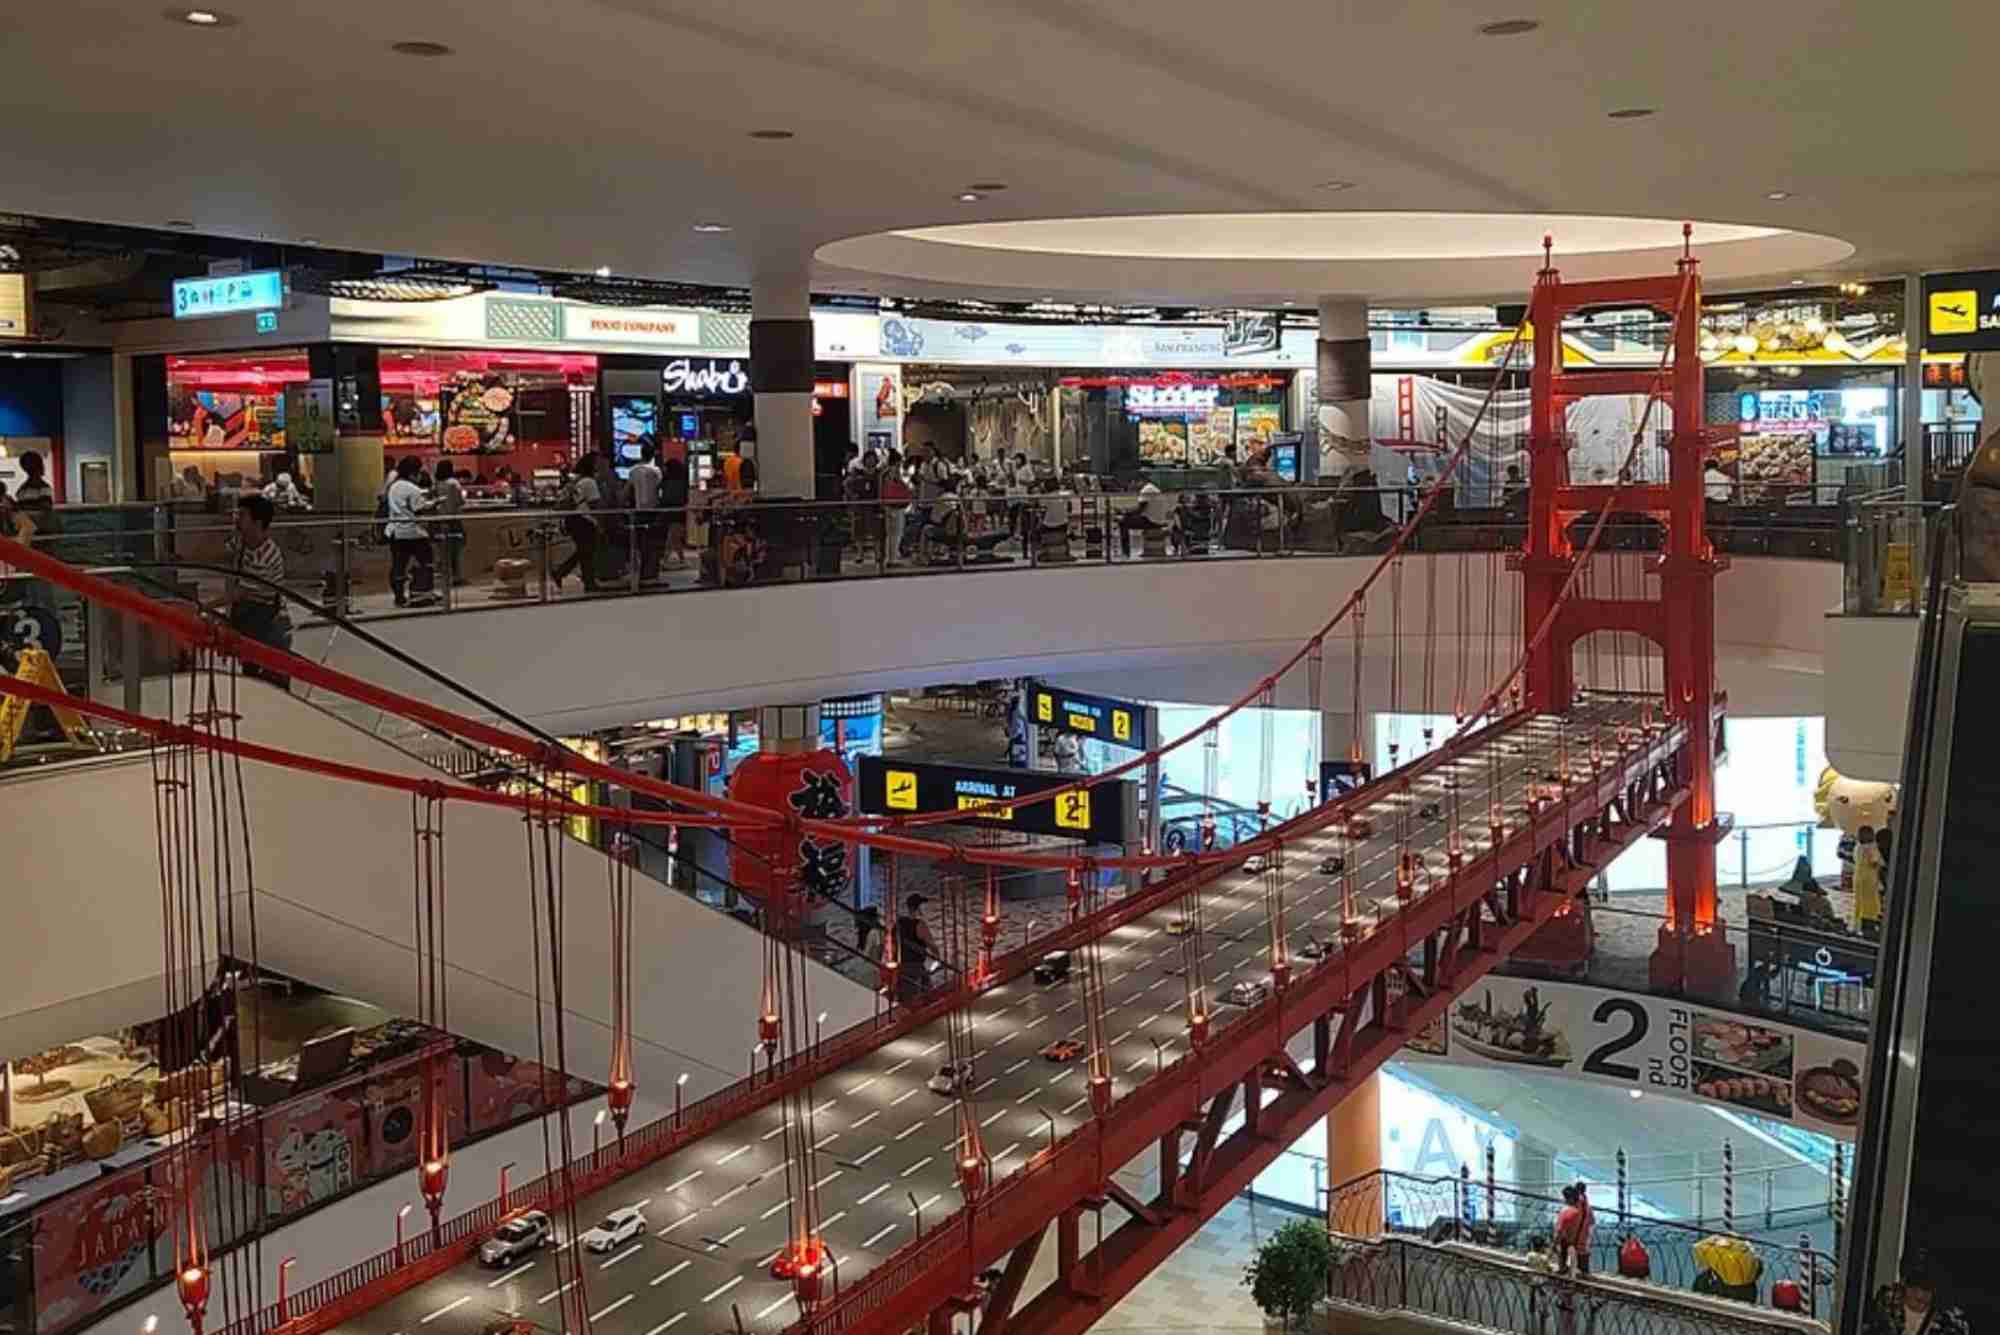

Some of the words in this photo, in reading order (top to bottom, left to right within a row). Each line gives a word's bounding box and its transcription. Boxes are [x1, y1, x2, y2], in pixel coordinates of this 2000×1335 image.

[178, 287, 188, 311] 3
[623, 321, 675, 334] COMPANY
[1116, 714, 1127, 735] 2
[955, 780, 998, 796] ARRIVAL
[1002, 785, 1016, 797] AT
[1063, 795, 1080, 822] 2
[1582, 997, 1649, 1081] 2
[1668, 1007, 1688, 1088] FLOOR
[1648, 1057, 1667, 1086] nd
[79, 1200, 167, 1267] JAPAN
